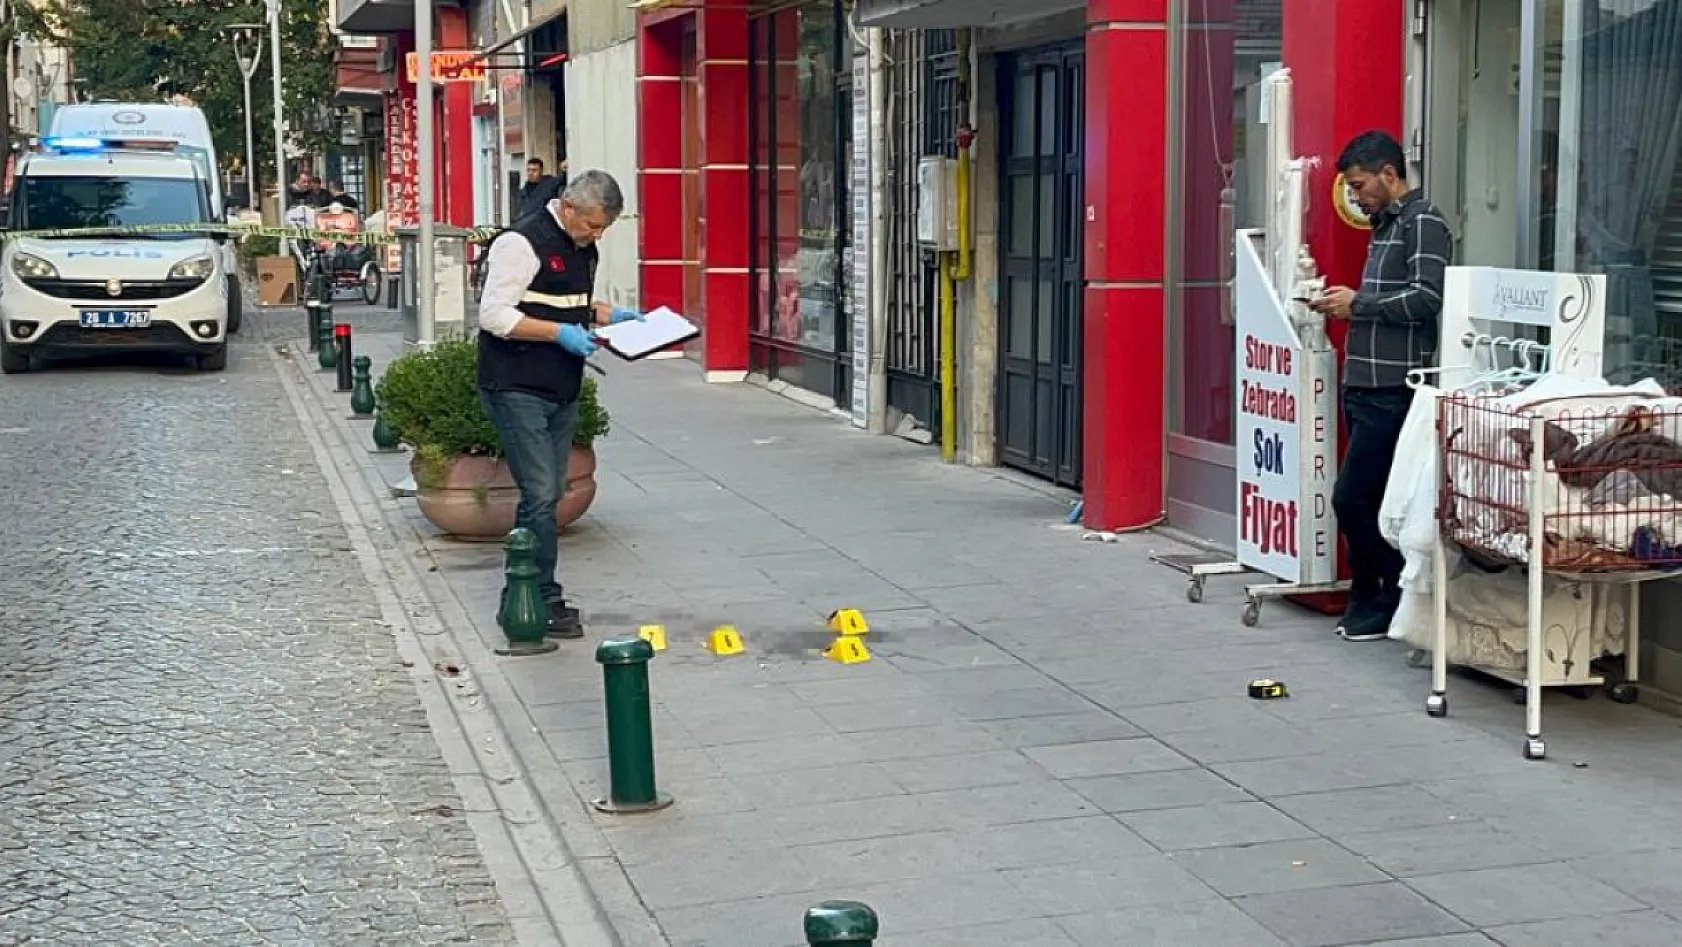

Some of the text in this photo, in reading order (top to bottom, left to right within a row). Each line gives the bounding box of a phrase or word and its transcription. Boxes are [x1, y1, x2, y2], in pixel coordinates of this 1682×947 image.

[107, 311, 115, 323] A
[1245, 334, 1292, 376] Stor ve
[1240, 379, 1296, 423] Zebrada
[1253, 428, 1284, 477] Şok
[1314, 378, 1326, 556] PERDE
[1240, 481, 1298, 558] Fiyat
